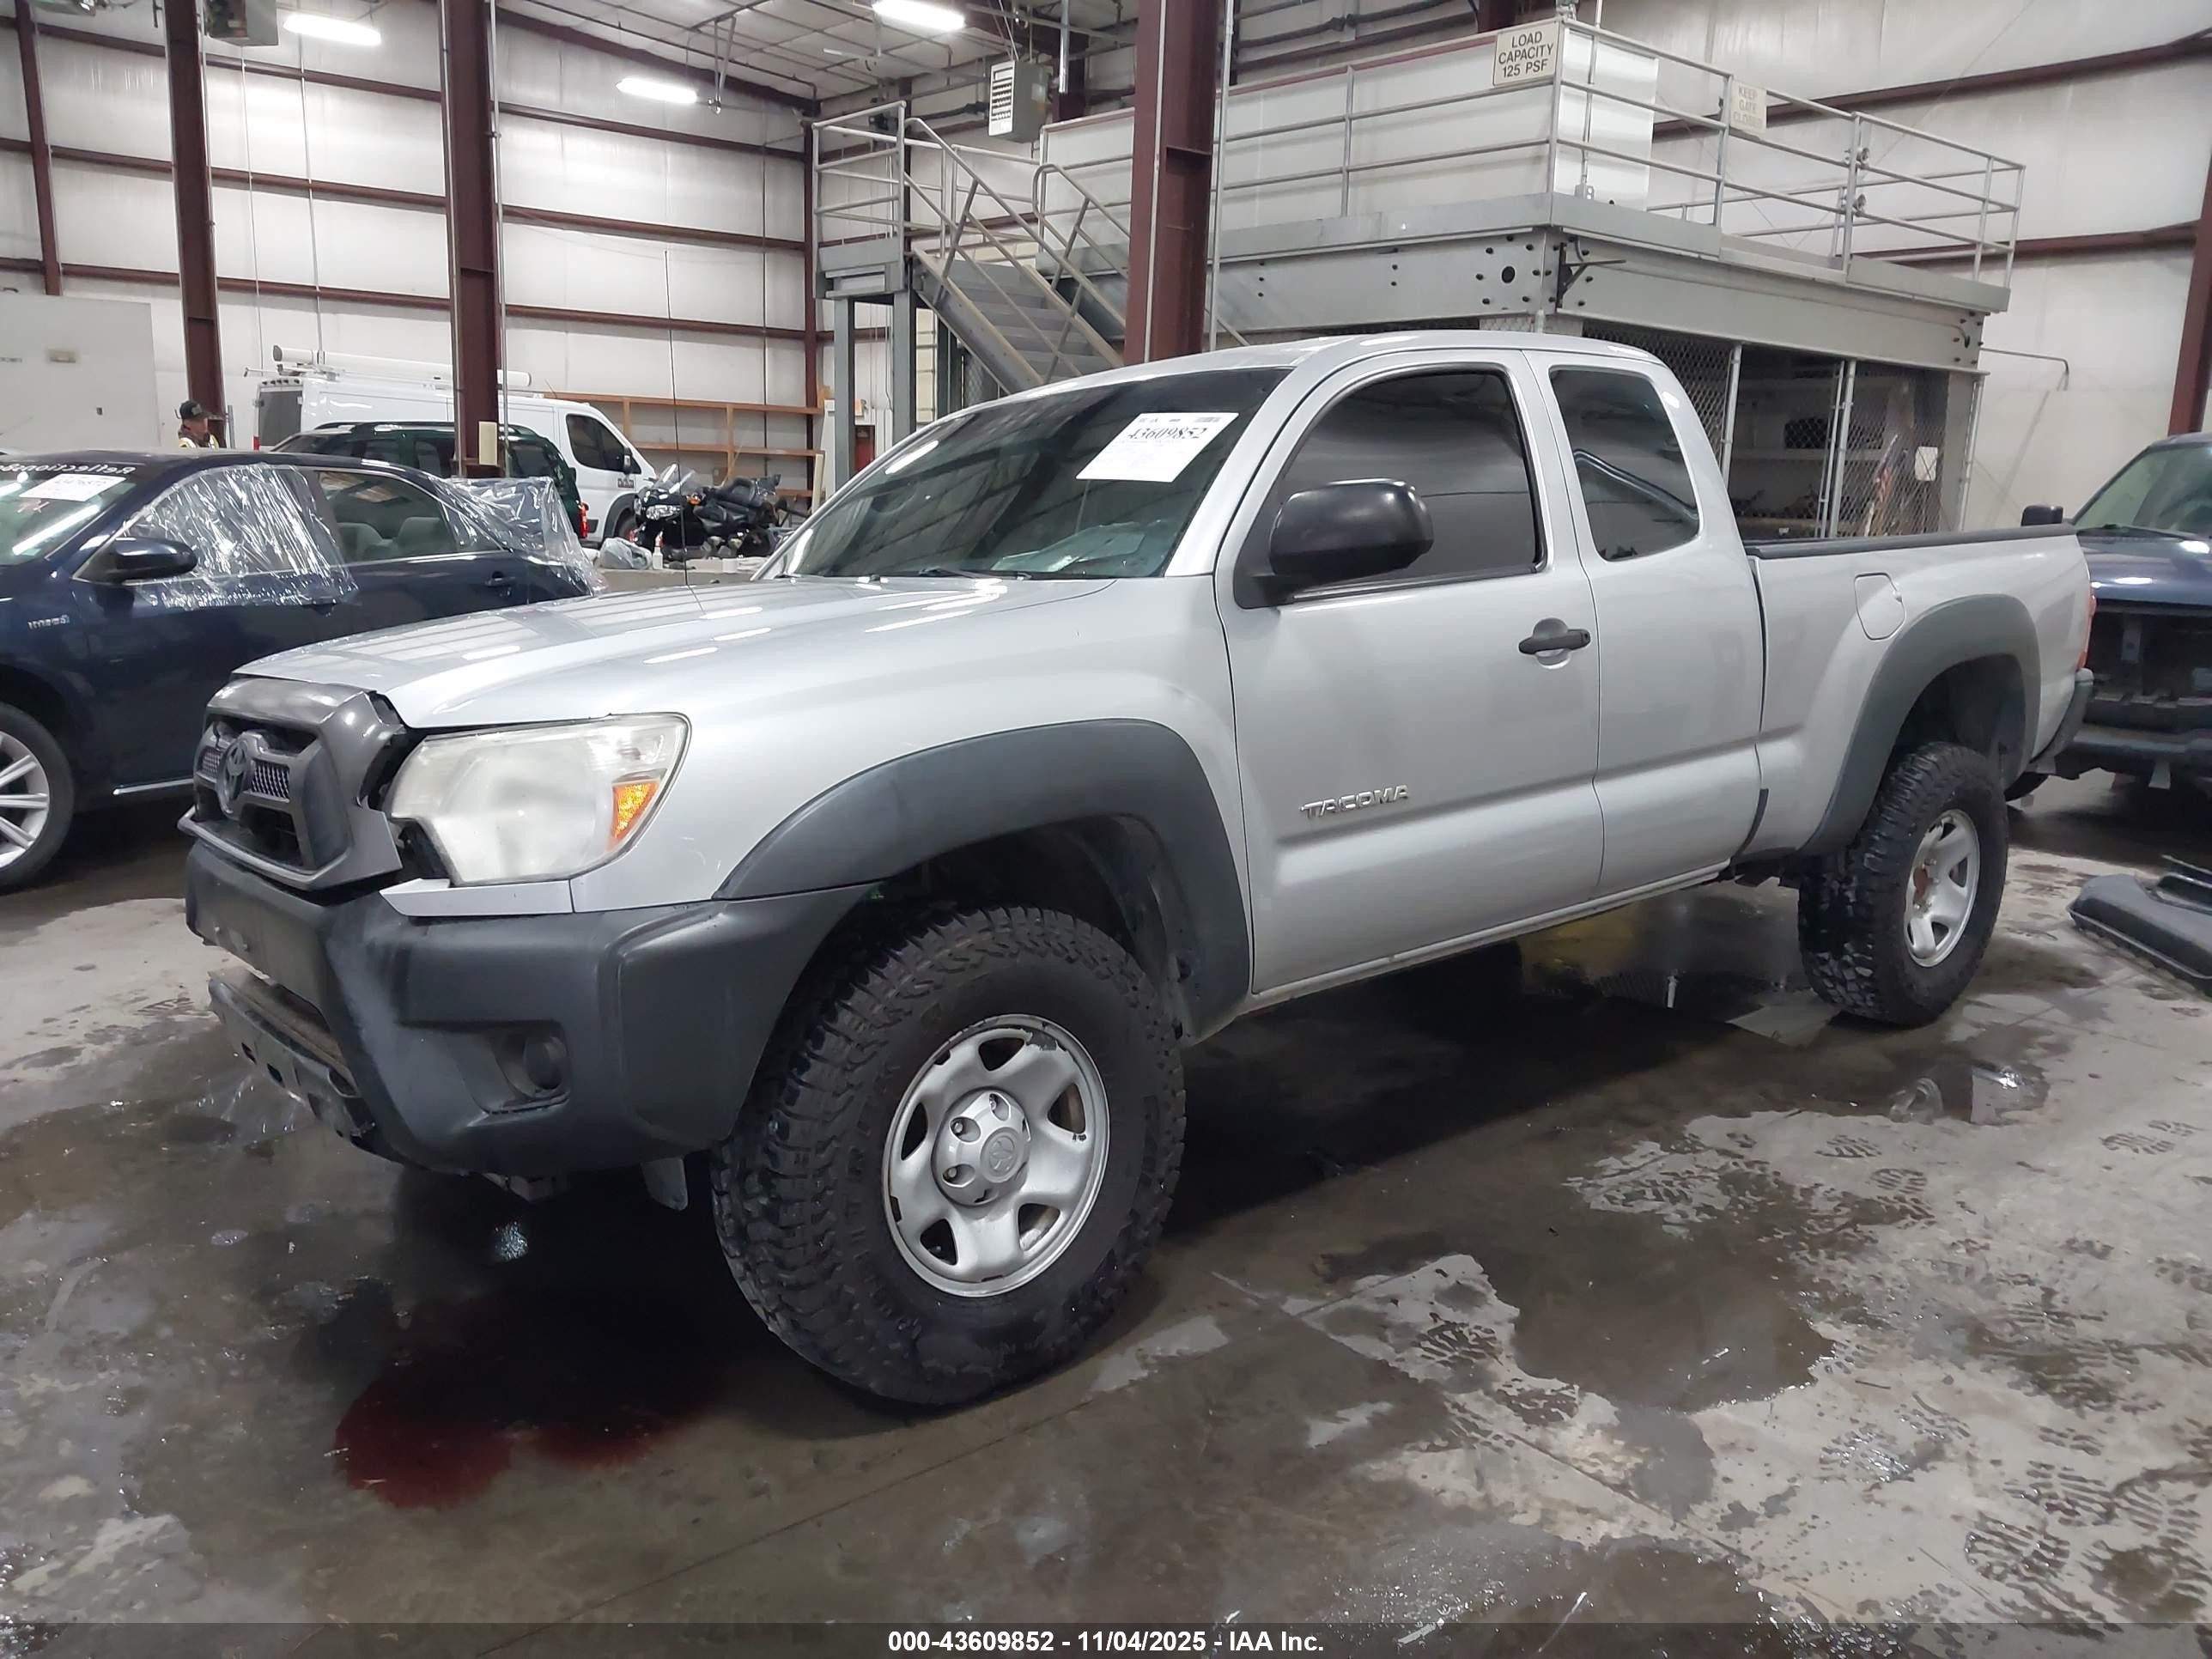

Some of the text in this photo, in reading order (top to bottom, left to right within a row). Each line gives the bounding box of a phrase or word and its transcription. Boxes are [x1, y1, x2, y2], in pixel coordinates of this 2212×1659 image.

[1511, 31, 1543, 48] LOAD
[1498, 43, 1553, 64] CAPACITY
[1503, 58, 1548, 78] 125 PSF
[1298, 784, 1409, 817] TACOMA
